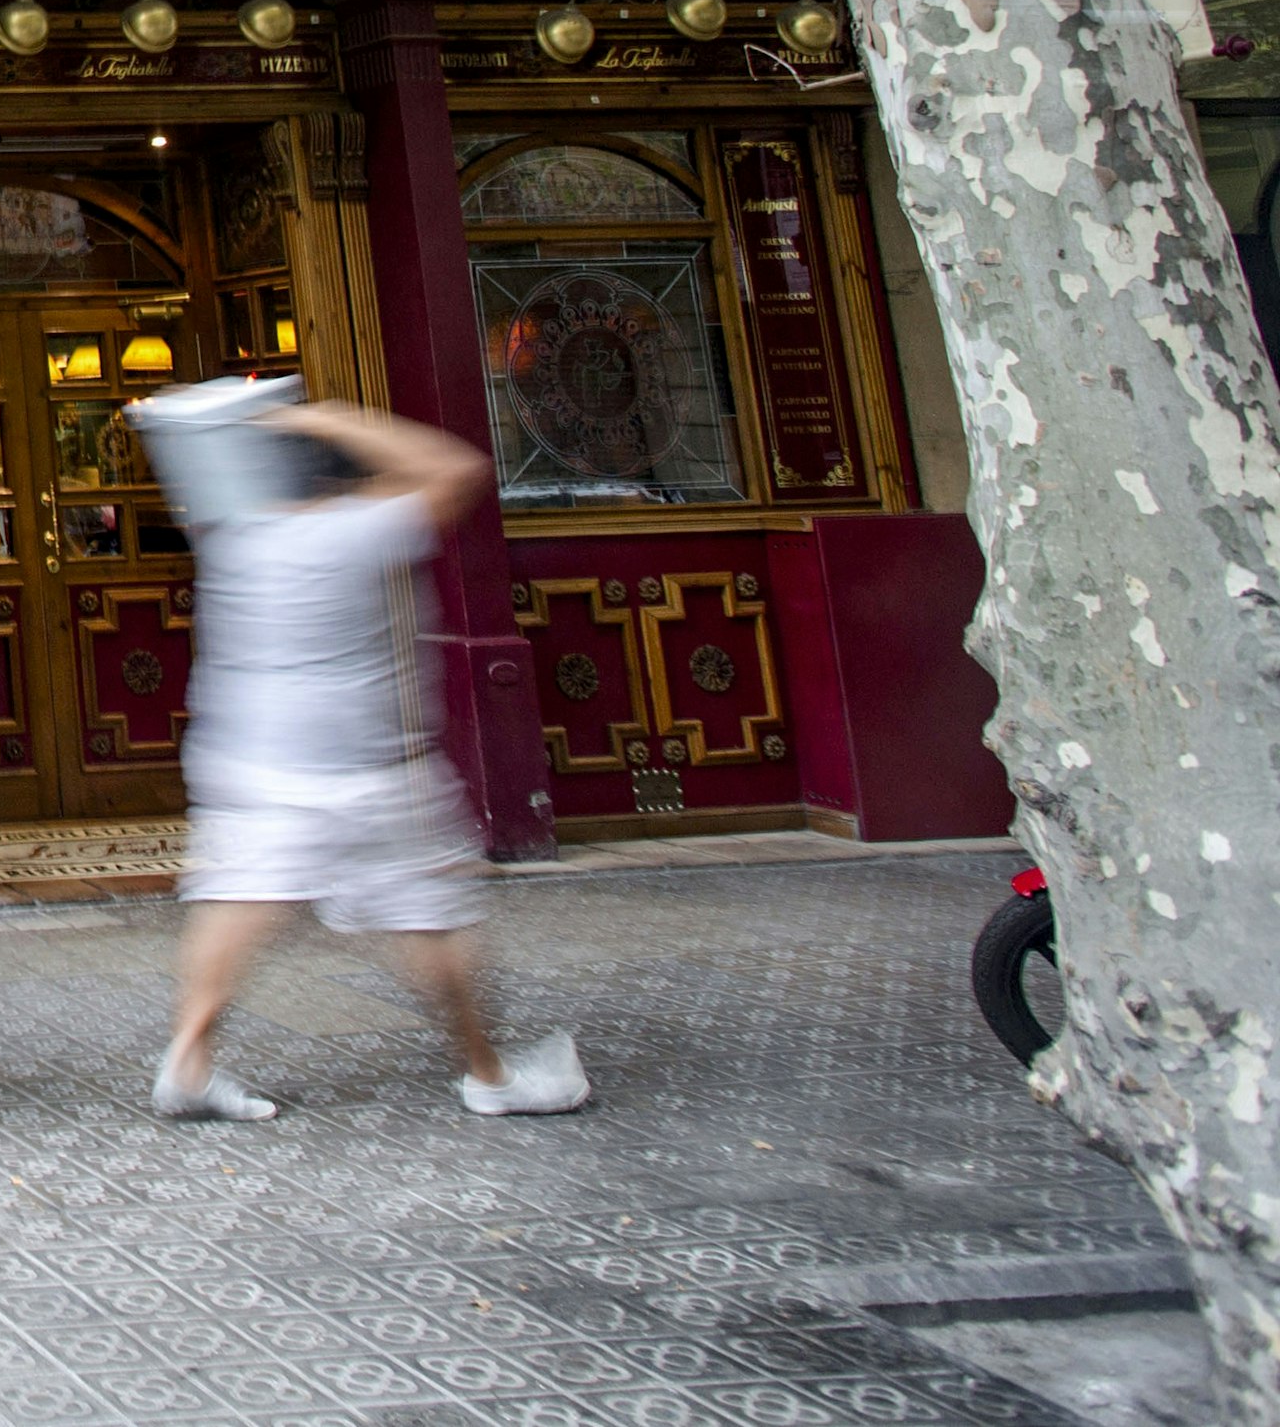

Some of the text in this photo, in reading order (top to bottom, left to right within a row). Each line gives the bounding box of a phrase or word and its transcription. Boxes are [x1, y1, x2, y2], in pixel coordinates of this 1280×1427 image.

[596, 47, 620, 68] La
[621, 43, 697, 71] Tagliatella
[95, 54, 175, 80] Tagliatella
[260, 57, 328, 73] PIZZERIE
[743, 197, 799, 214] Antipasti
[760, 237, 793, 246] CREMA
[760, 292, 811, 301] CARPACCIO
